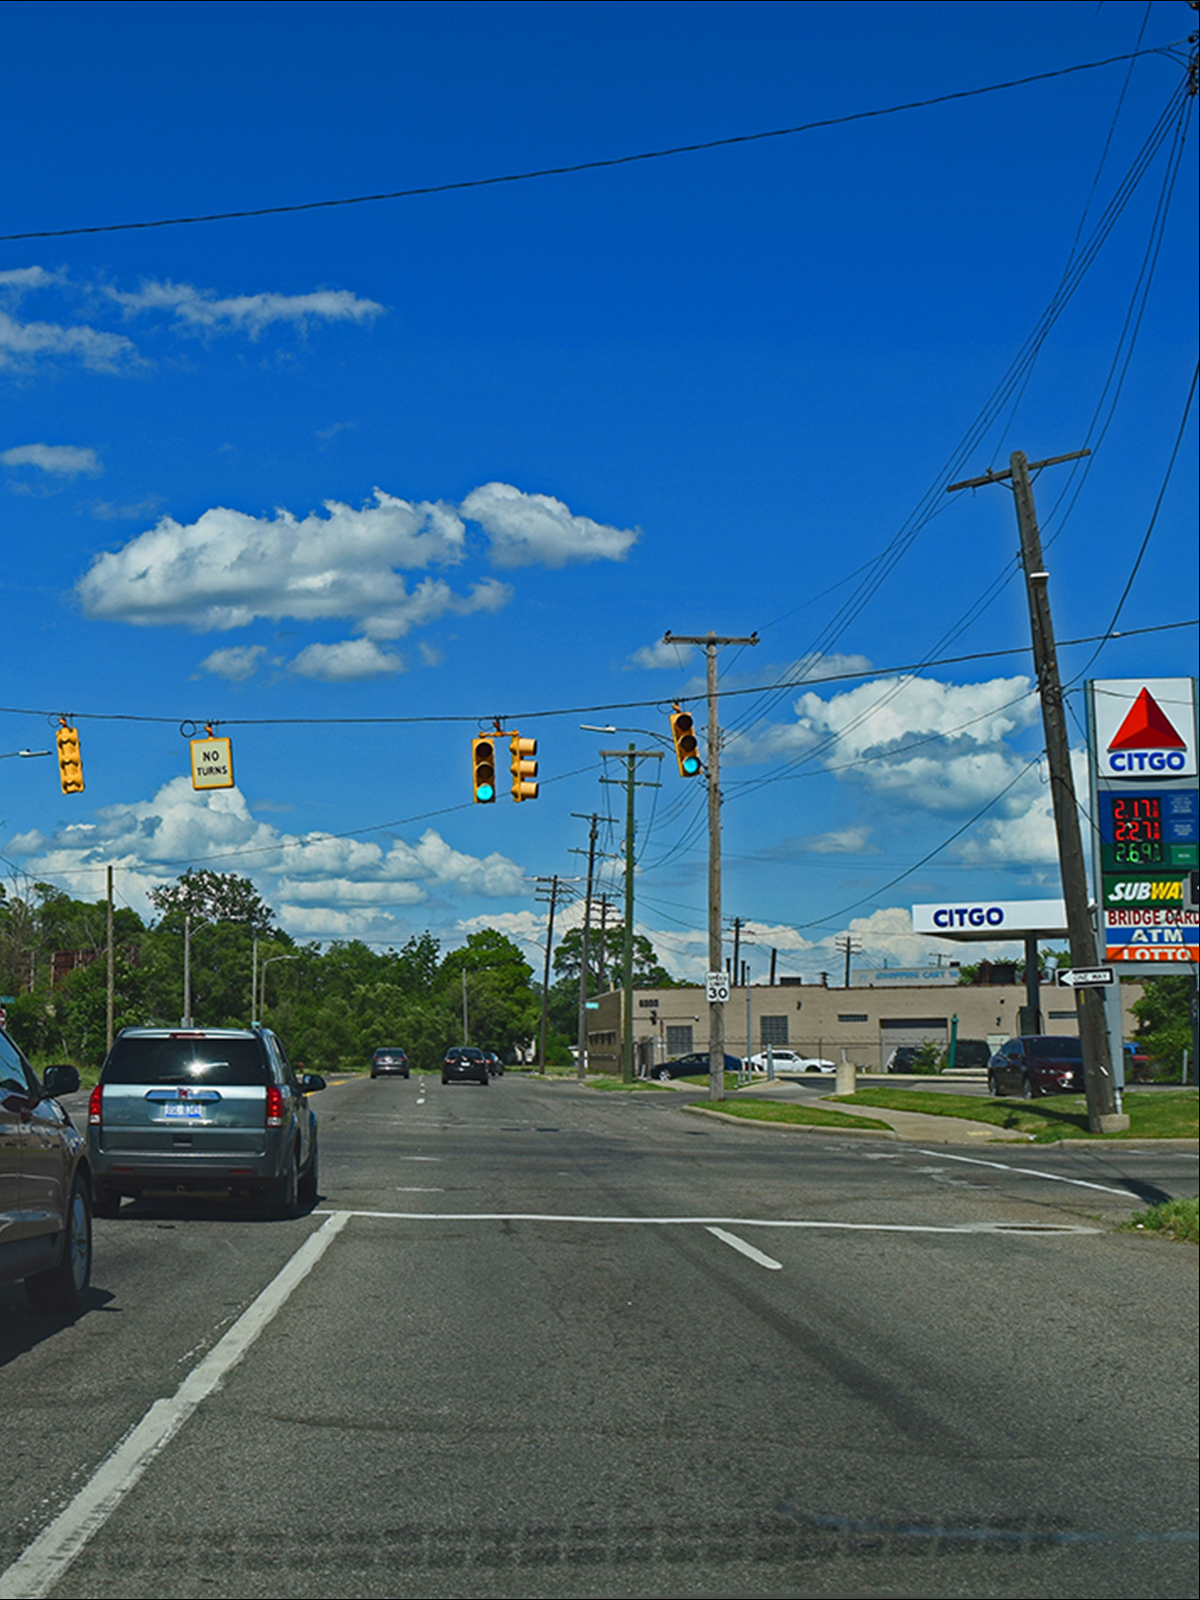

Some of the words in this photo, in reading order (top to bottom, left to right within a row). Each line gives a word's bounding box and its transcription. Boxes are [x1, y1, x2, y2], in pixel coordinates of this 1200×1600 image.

[202, 750, 220, 762] NO
[1109, 751, 1186, 772] CITGO
[196, 765, 228, 777] TURNS
[1108, 881, 1184, 901] SUBWA
[933, 906, 1005, 928] CITGO
[1108, 909, 1161, 925] BRIDGE
[1131, 928, 1183, 942] ATM
[1123, 948, 1191, 961] LOTTO
[922, 970, 945, 979] CART
[1073, 973, 1088, 981] ONE
[709, 987, 728, 999] 30
